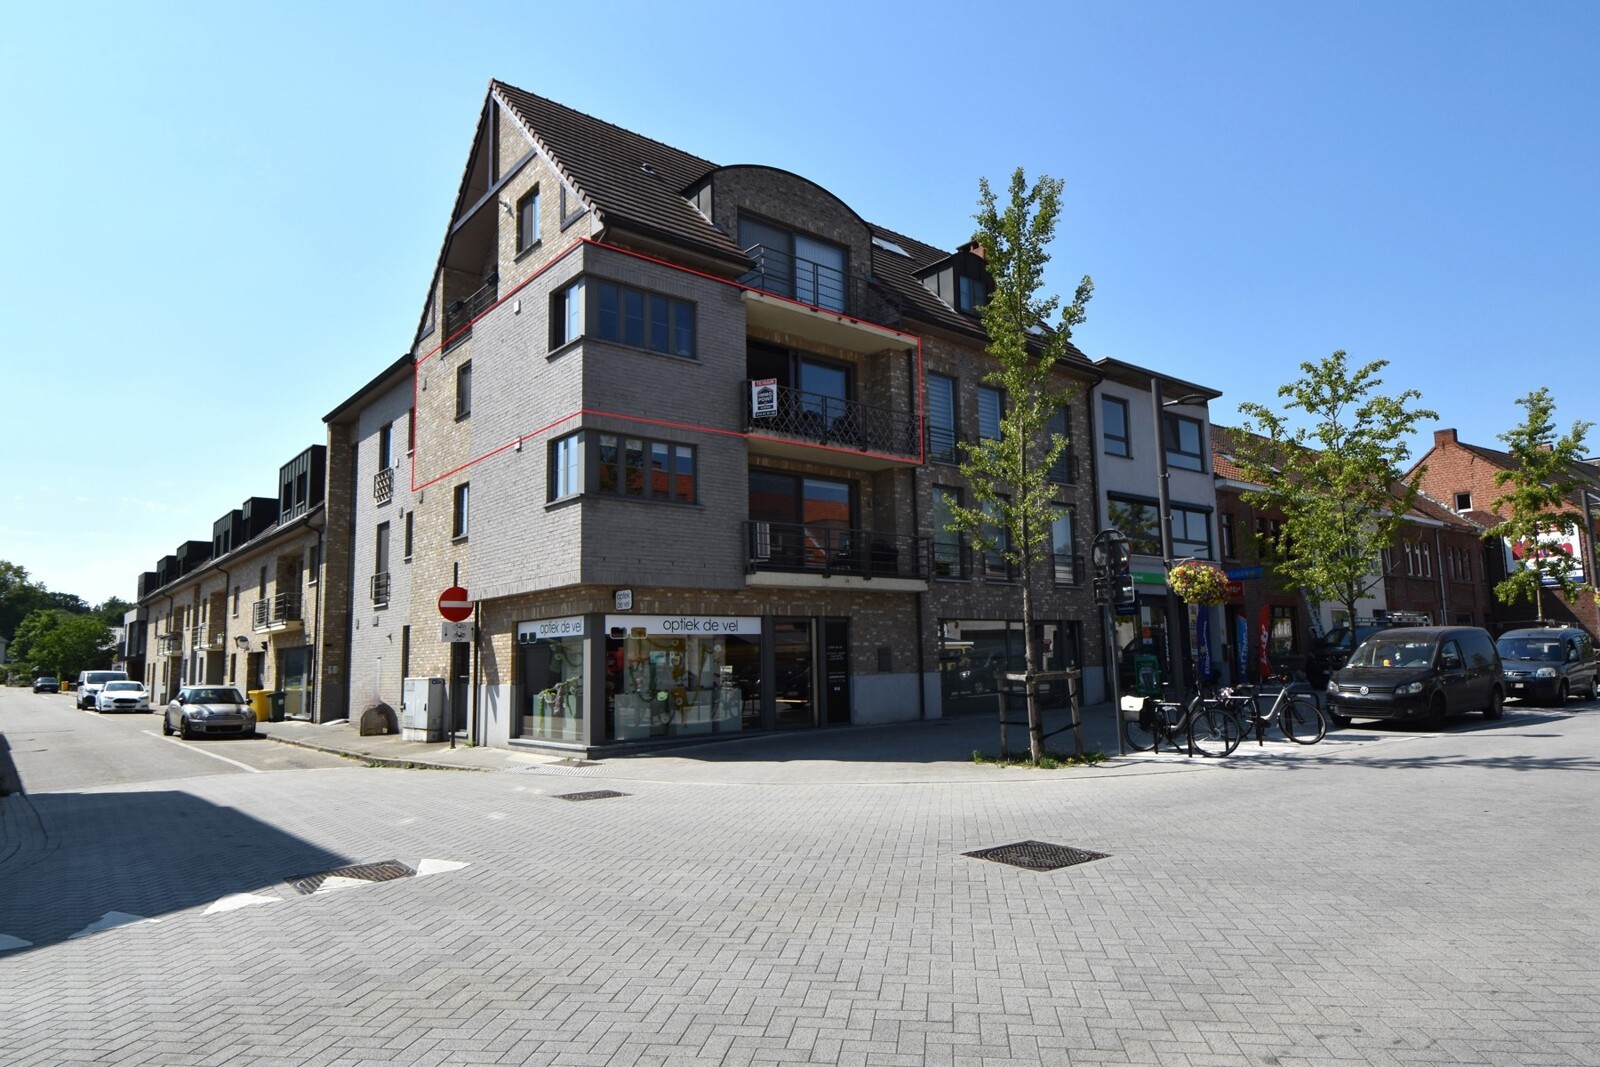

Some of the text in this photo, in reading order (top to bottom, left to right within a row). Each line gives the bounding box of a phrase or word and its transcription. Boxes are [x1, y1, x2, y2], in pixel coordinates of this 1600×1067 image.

[539, 619, 582, 636] optiek de vel
[662, 618, 739, 633] optiek de vel
